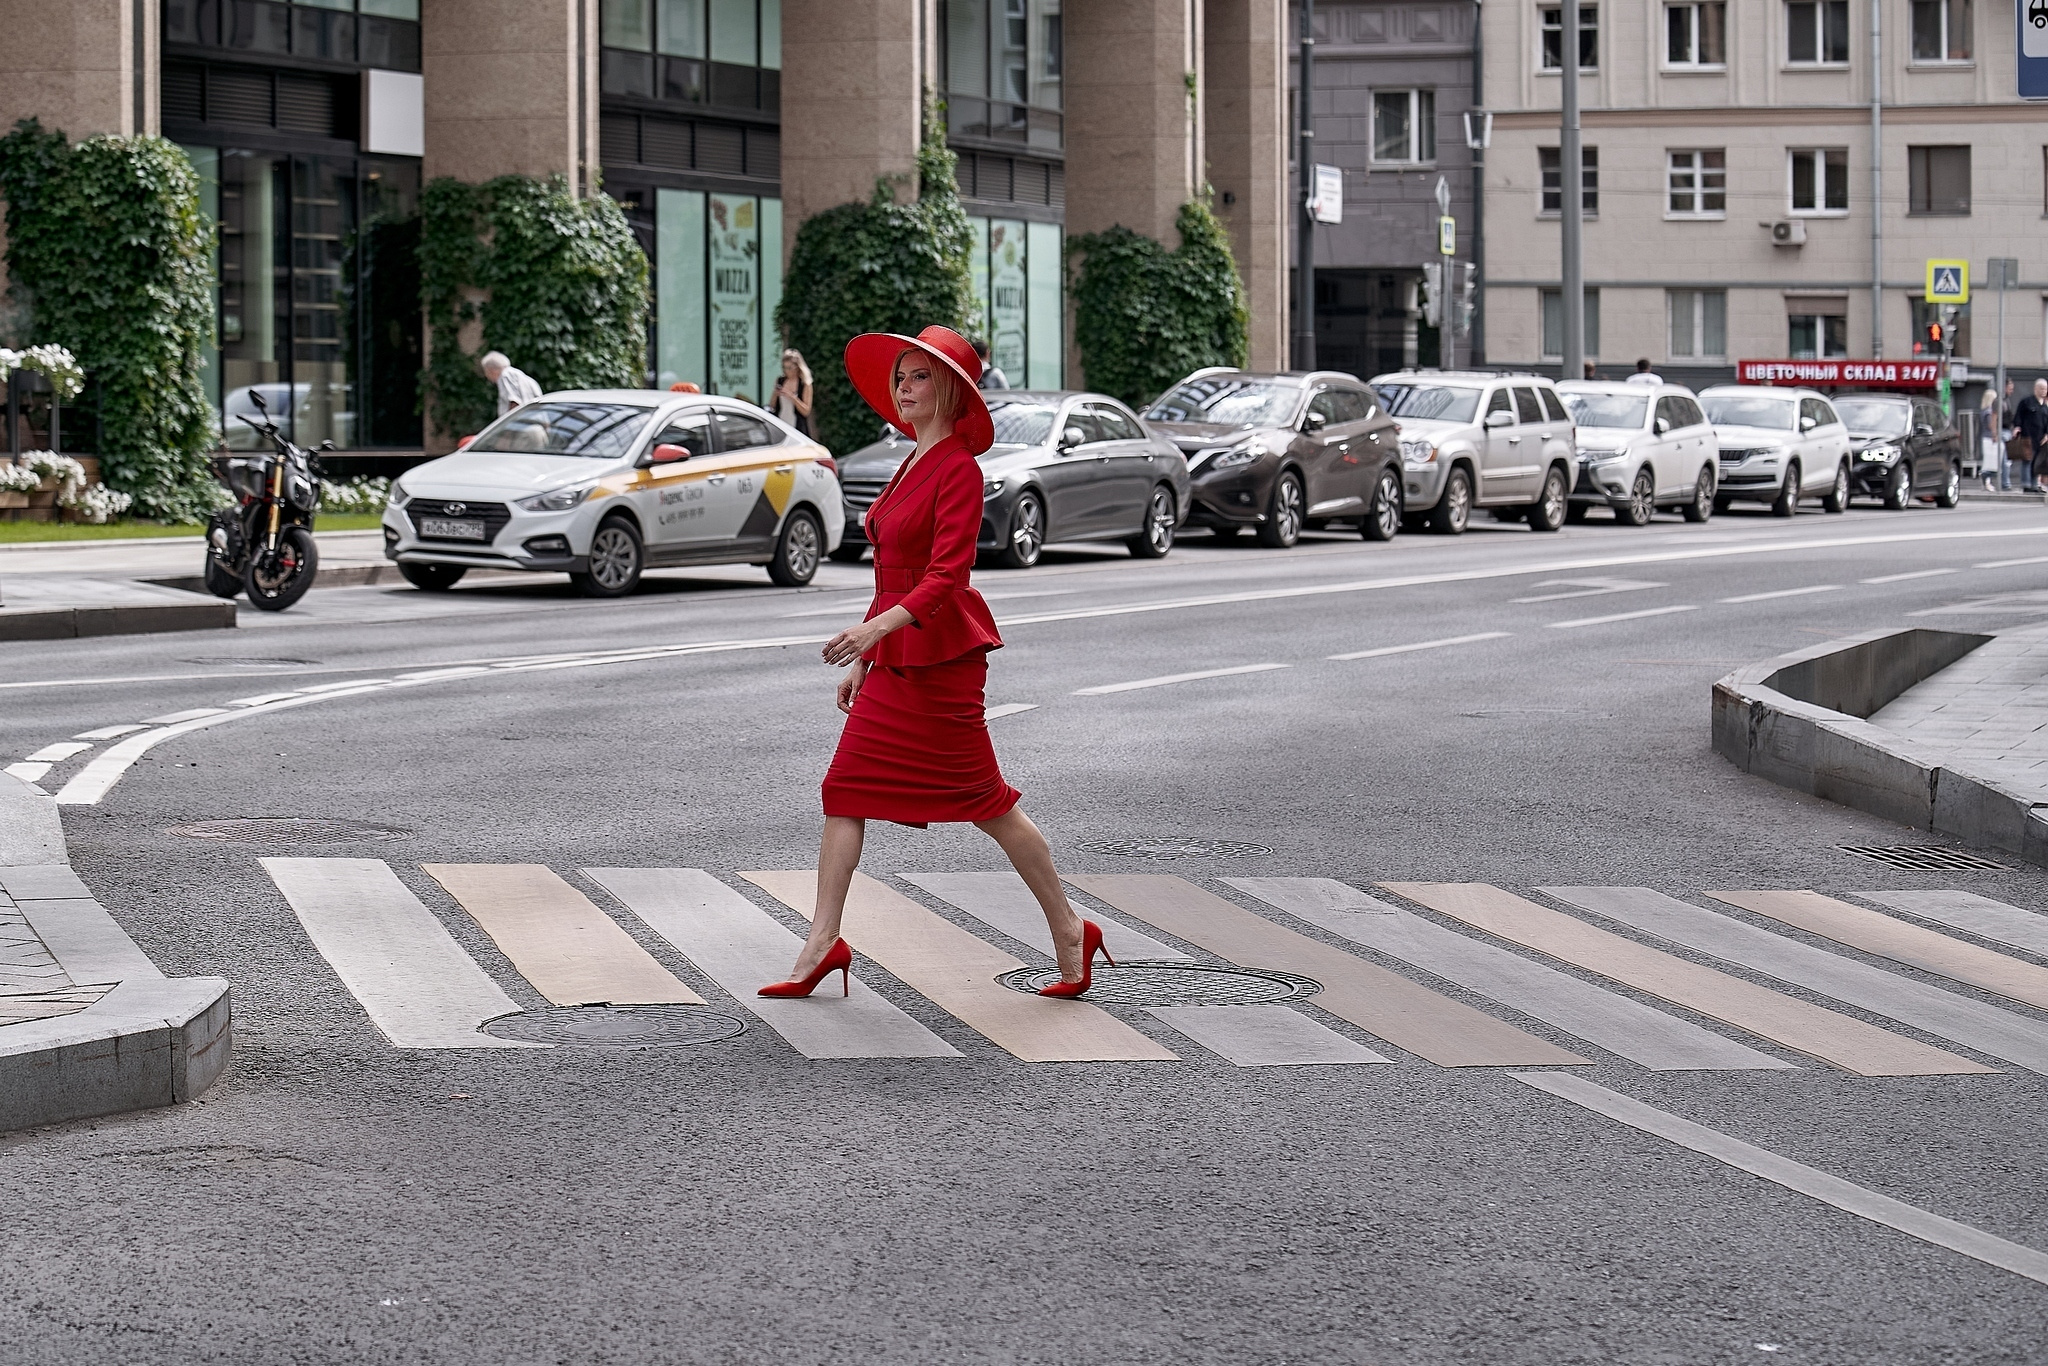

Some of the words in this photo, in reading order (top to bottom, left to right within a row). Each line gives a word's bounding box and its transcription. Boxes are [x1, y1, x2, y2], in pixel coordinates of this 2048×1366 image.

[716, 268, 750, 293] MOZZA
[1745, 364, 1838, 381] ЦВЕТОЧНЫЙ
[1844, 365, 1896, 381] СКЛАД
[1902, 366, 1937, 381] 24/7
